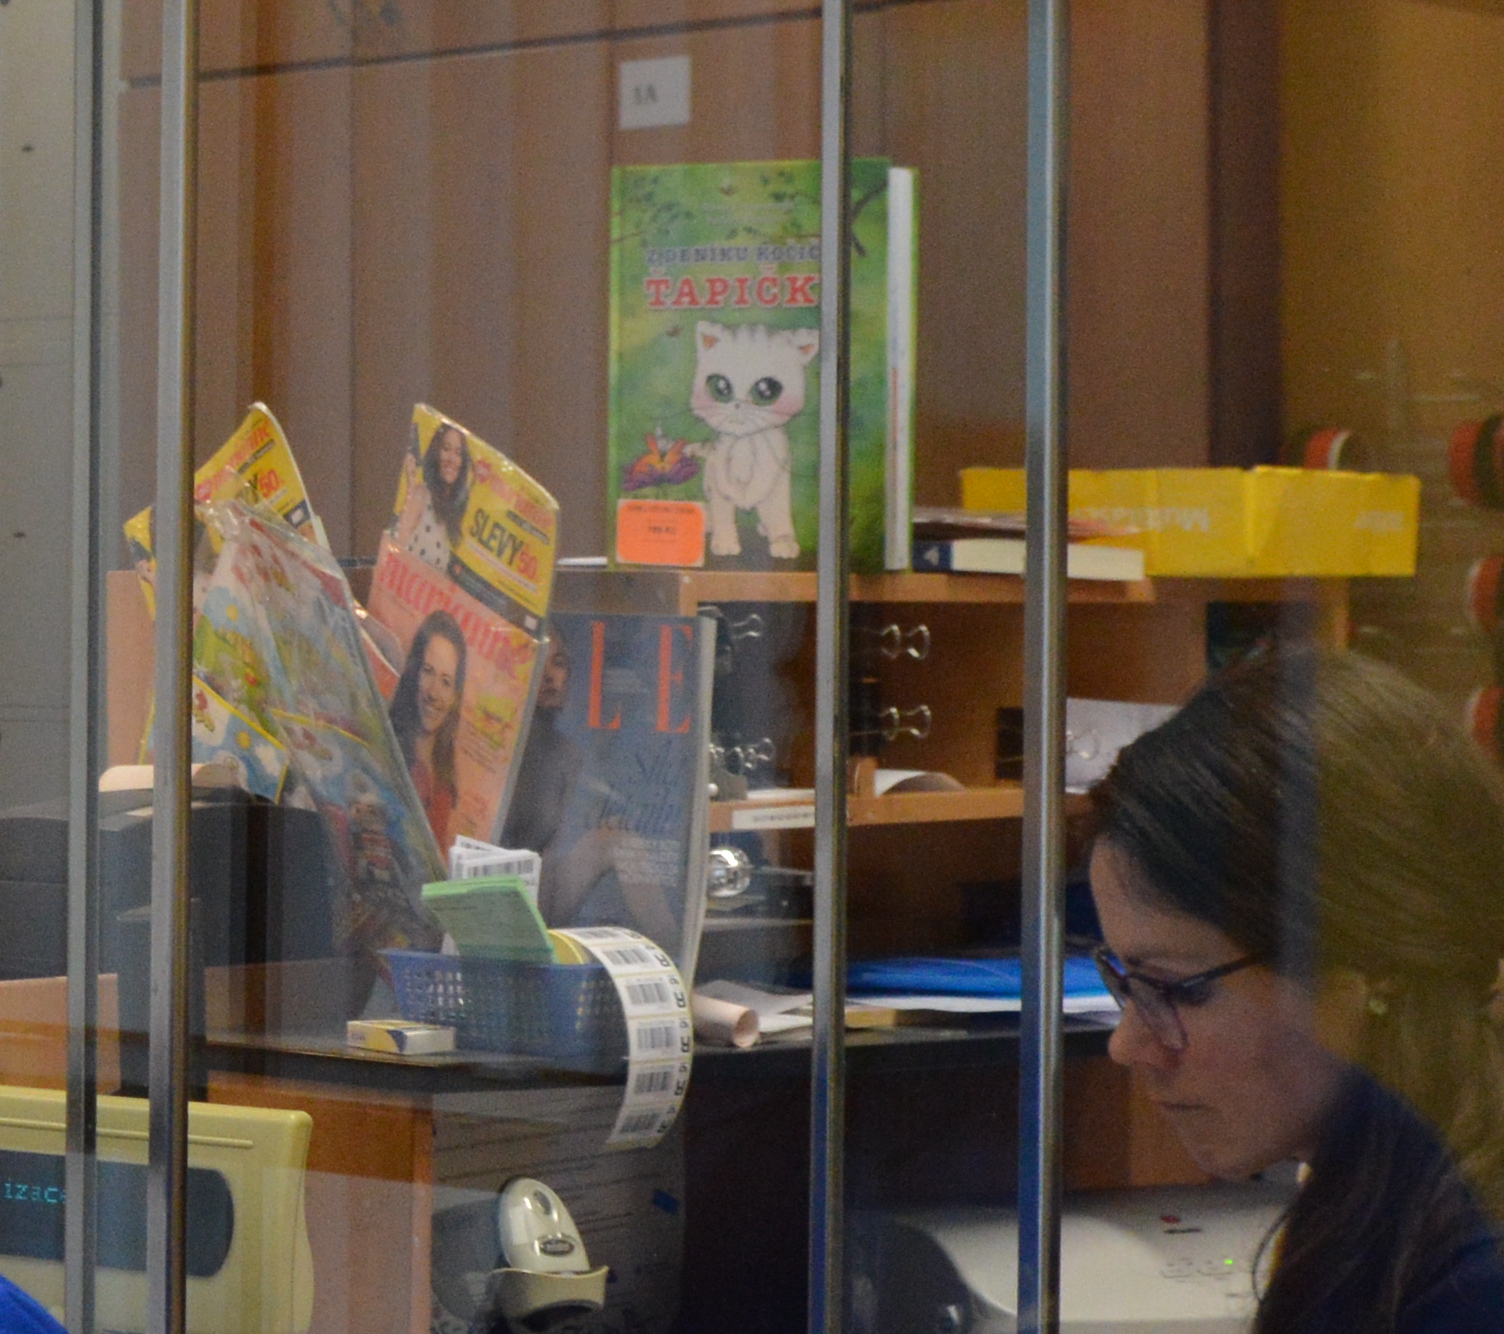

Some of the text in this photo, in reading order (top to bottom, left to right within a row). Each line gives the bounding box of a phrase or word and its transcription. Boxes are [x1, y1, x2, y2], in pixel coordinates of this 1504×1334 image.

[645, 264, 820, 308] ŤAPIČK
[469, 508, 525, 566] SLEVY
[587, 620, 693, 733] LE
